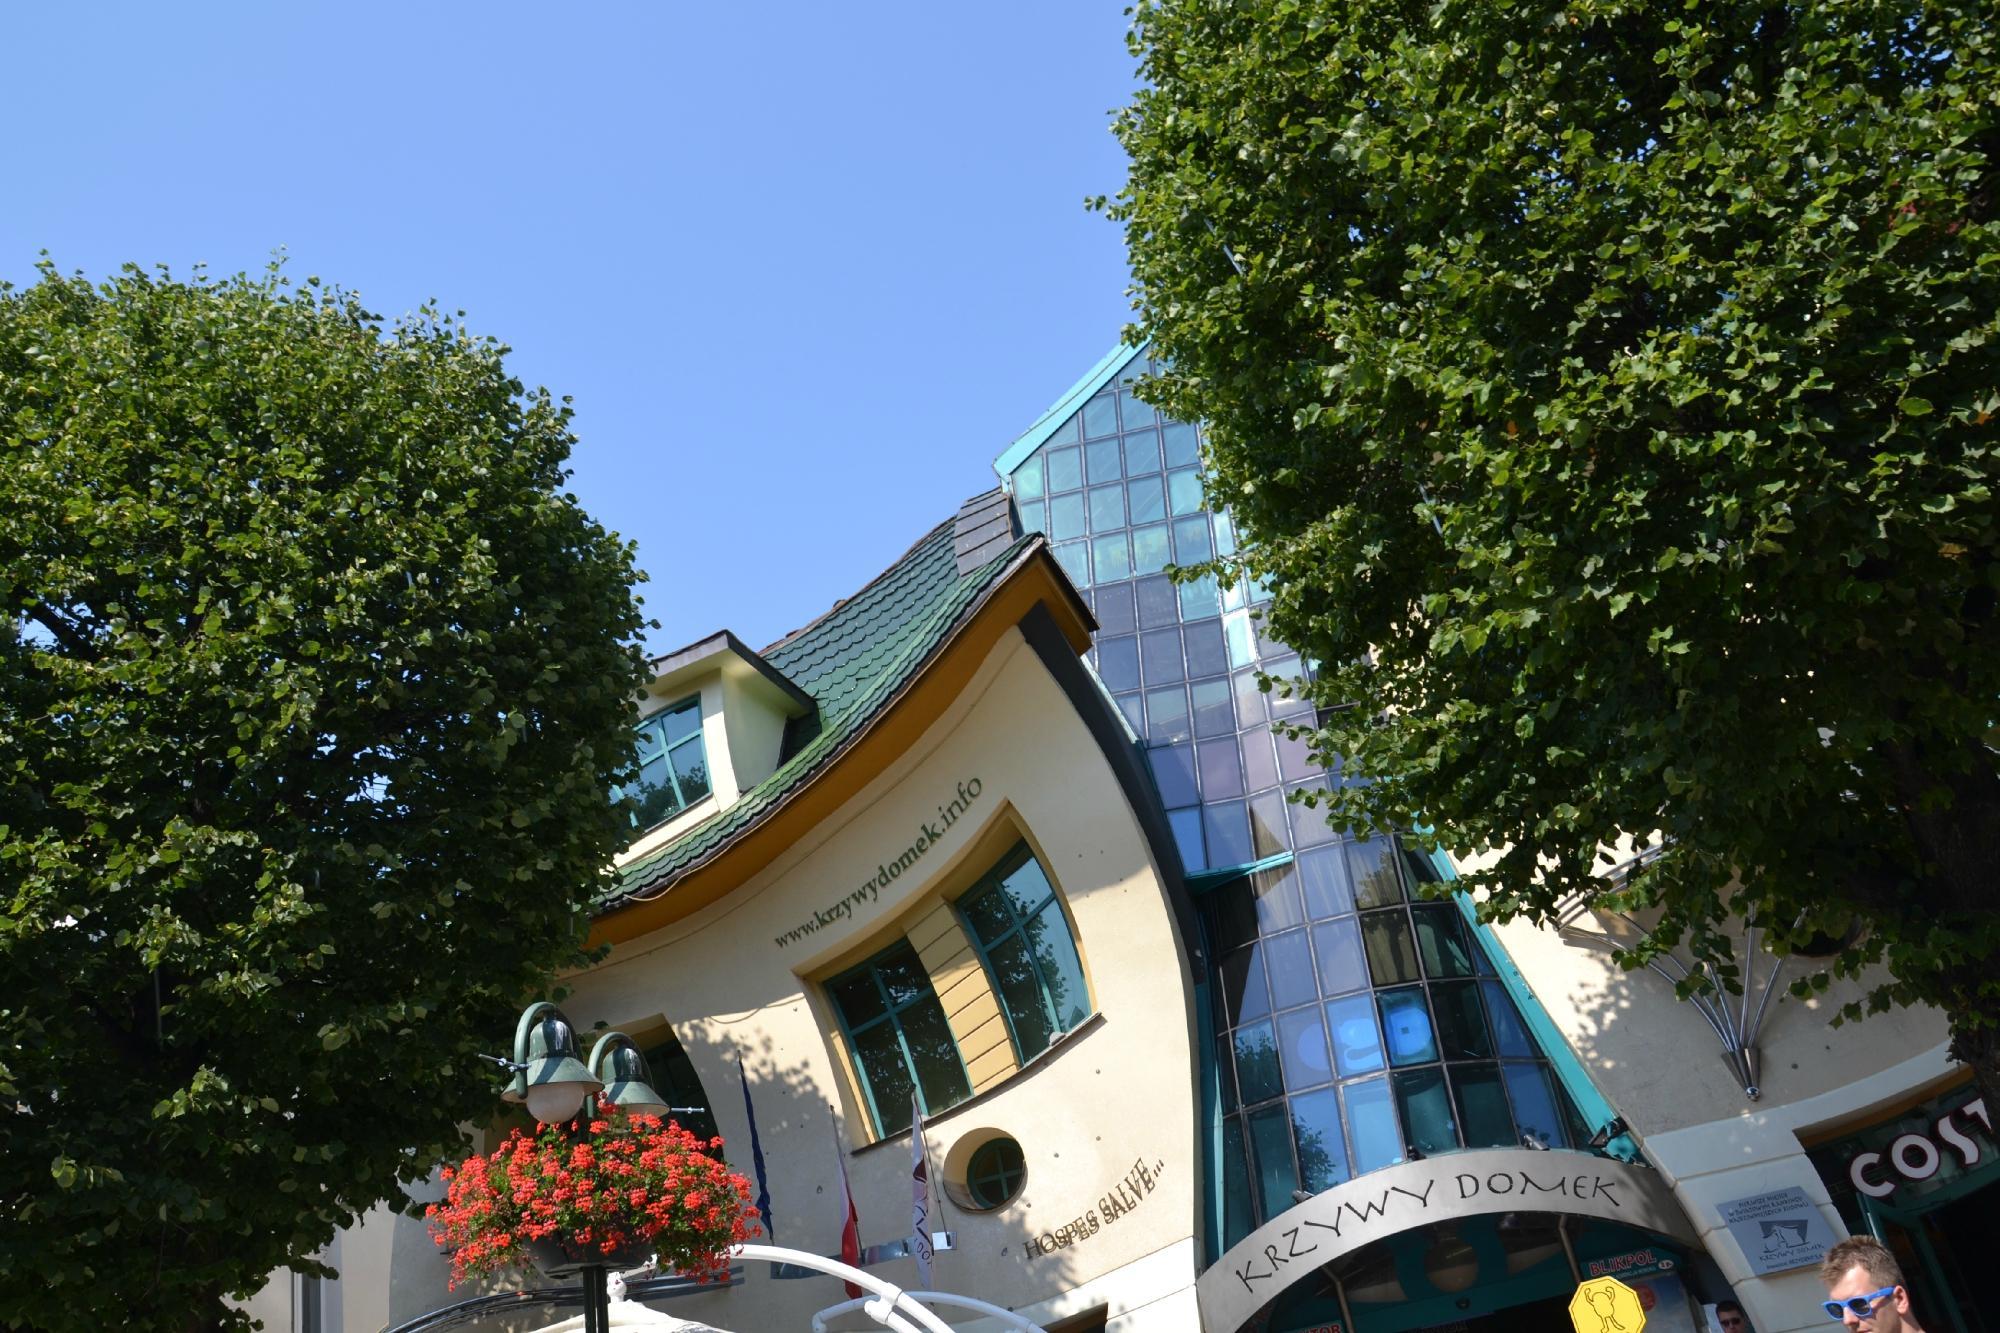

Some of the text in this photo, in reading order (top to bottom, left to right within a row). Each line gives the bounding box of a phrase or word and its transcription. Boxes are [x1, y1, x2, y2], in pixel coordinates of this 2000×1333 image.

[775, 776, 982, 949] www.krzywydomek.info
[1022, 1210, 1099, 1260] HOSPES
[1235, 1171, 1621, 1294] KRZYWY DOMEK
[1588, 1248, 1657, 1277] BLIKPOL
